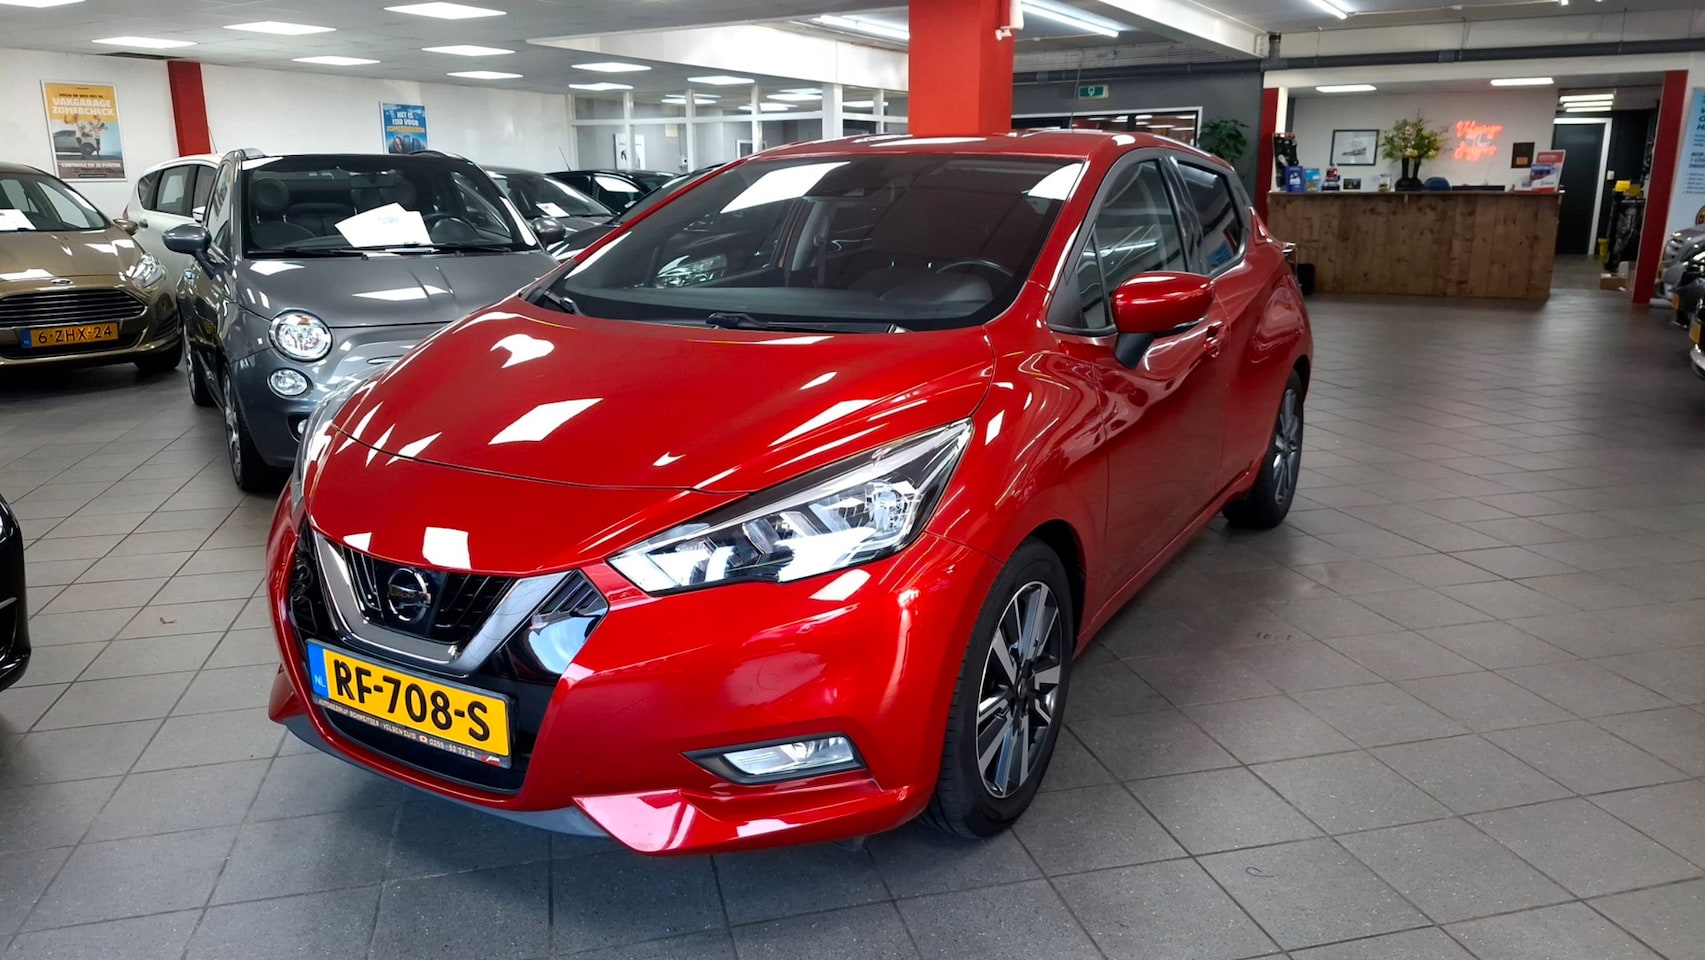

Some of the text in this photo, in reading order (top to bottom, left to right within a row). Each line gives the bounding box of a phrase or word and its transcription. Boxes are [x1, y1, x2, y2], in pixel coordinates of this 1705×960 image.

[53, 97, 111, 108] VAKGARAGE
[53, 106, 113, 116] ZOMERCHECK
[38, 326, 112, 344] 6-ZHX-24
[314, 674, 326, 688] NL
[334, 659, 490, 742] RF-708-S
